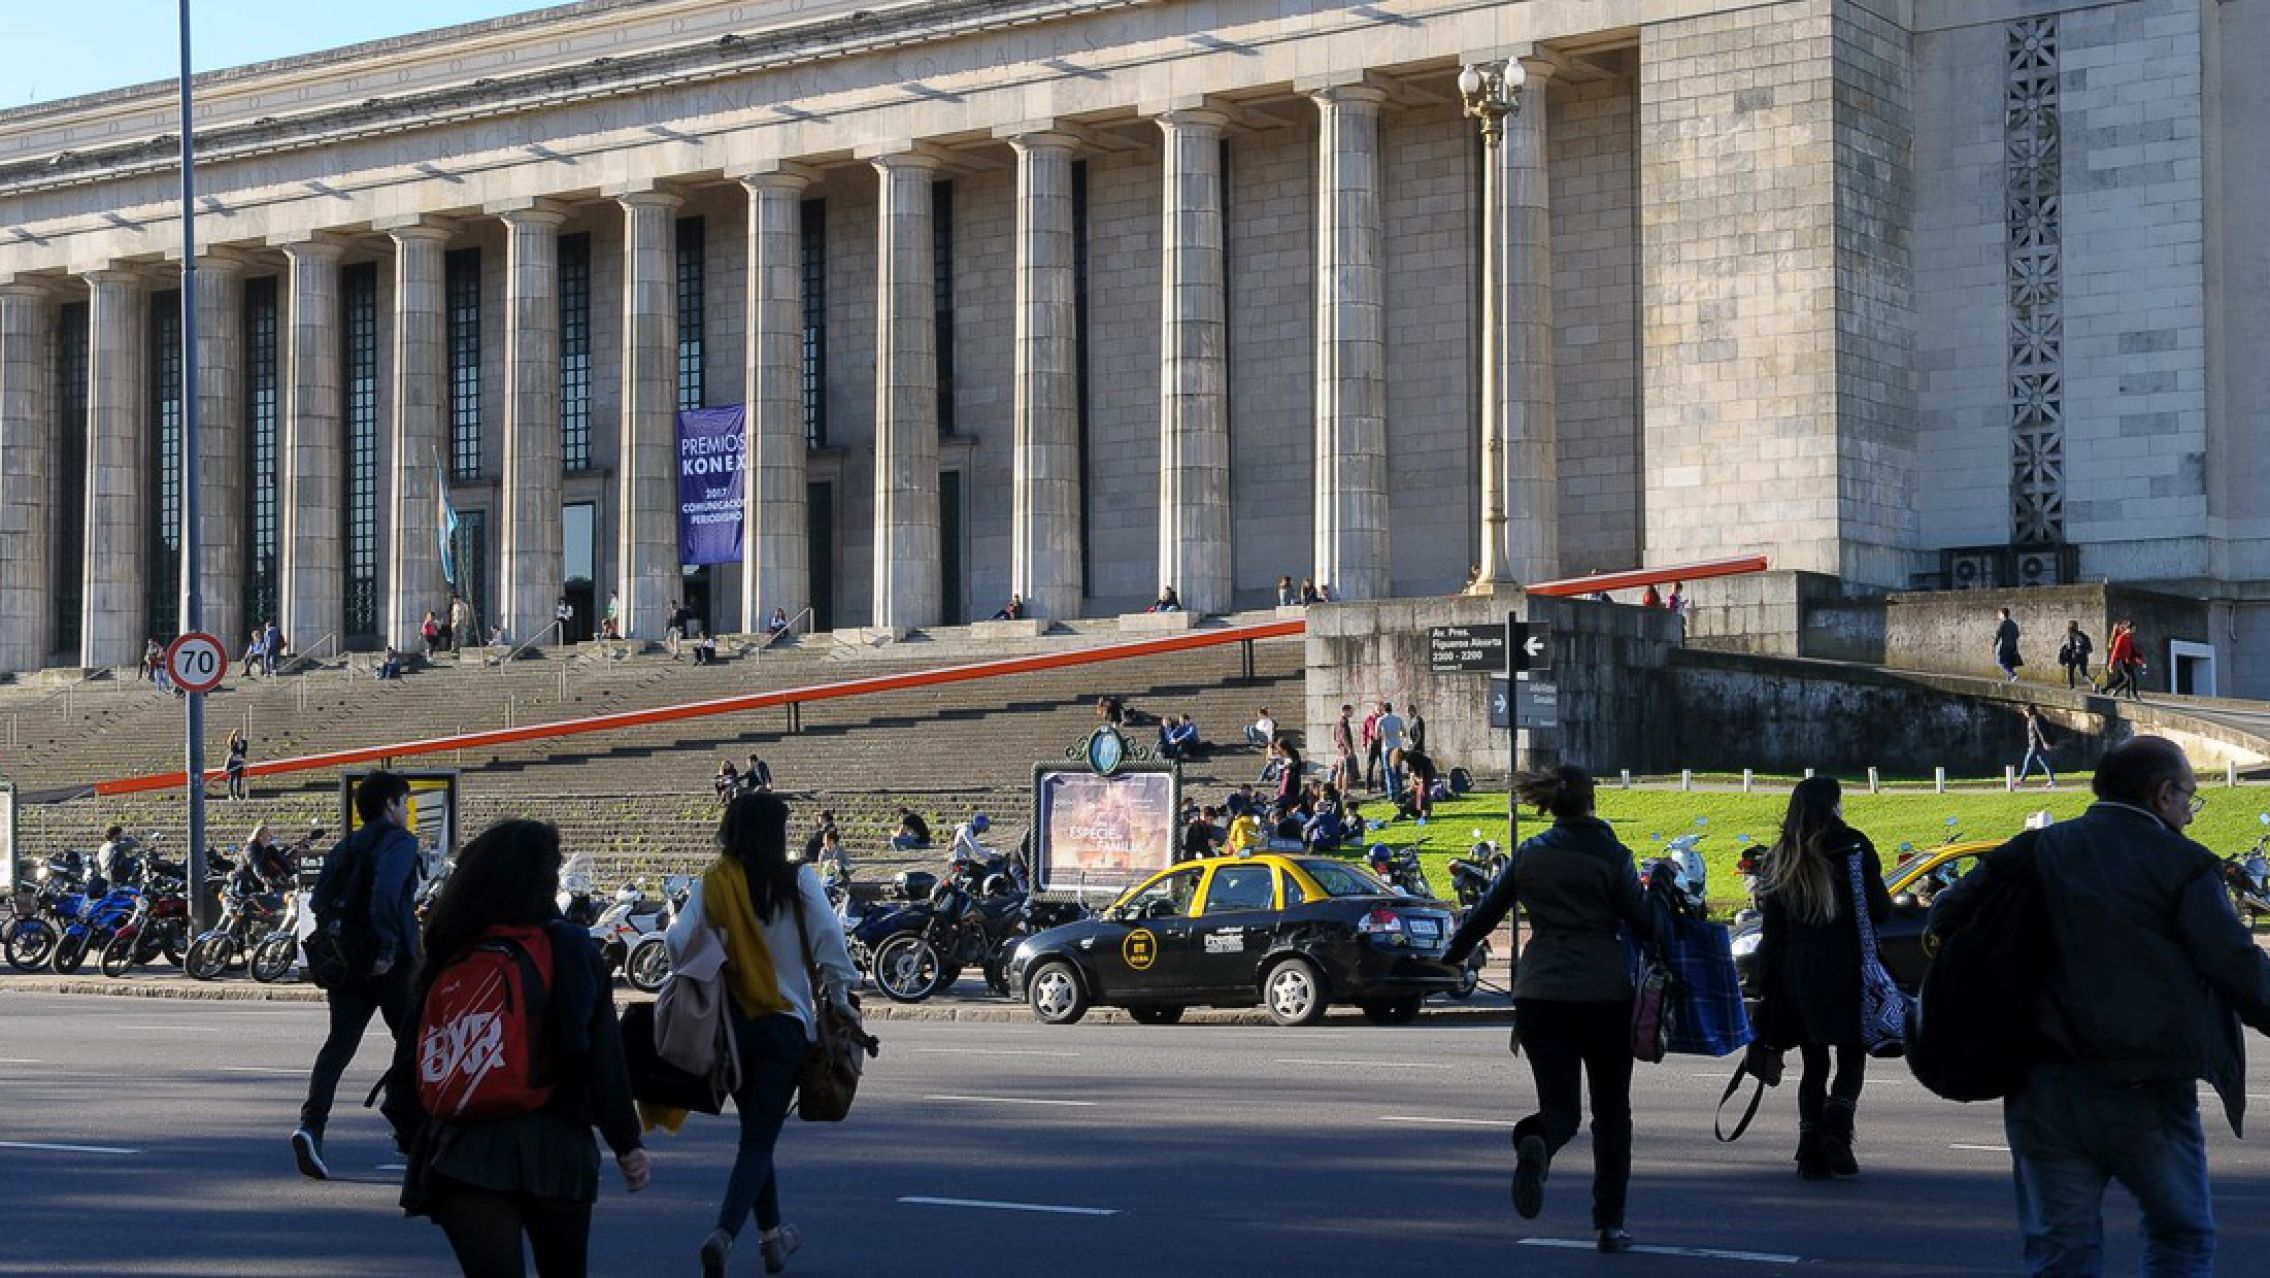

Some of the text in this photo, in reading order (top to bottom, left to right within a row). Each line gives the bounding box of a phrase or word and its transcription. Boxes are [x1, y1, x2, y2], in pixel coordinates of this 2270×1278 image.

[893, 30, 1099, 83] SOCIALES
[681, 433, 746, 456] PREMIOS
[682, 455, 746, 476] KONEX
[705, 488, 727, 498] 2017
[691, 512, 743, 524] PERIODISMO
[1448, 628, 1470, 637] Pres.
[1432, 639, 1469, 650] Figueroa
[1461, 650, 1483, 660] 2200
[182, 651, 214, 674] 70
